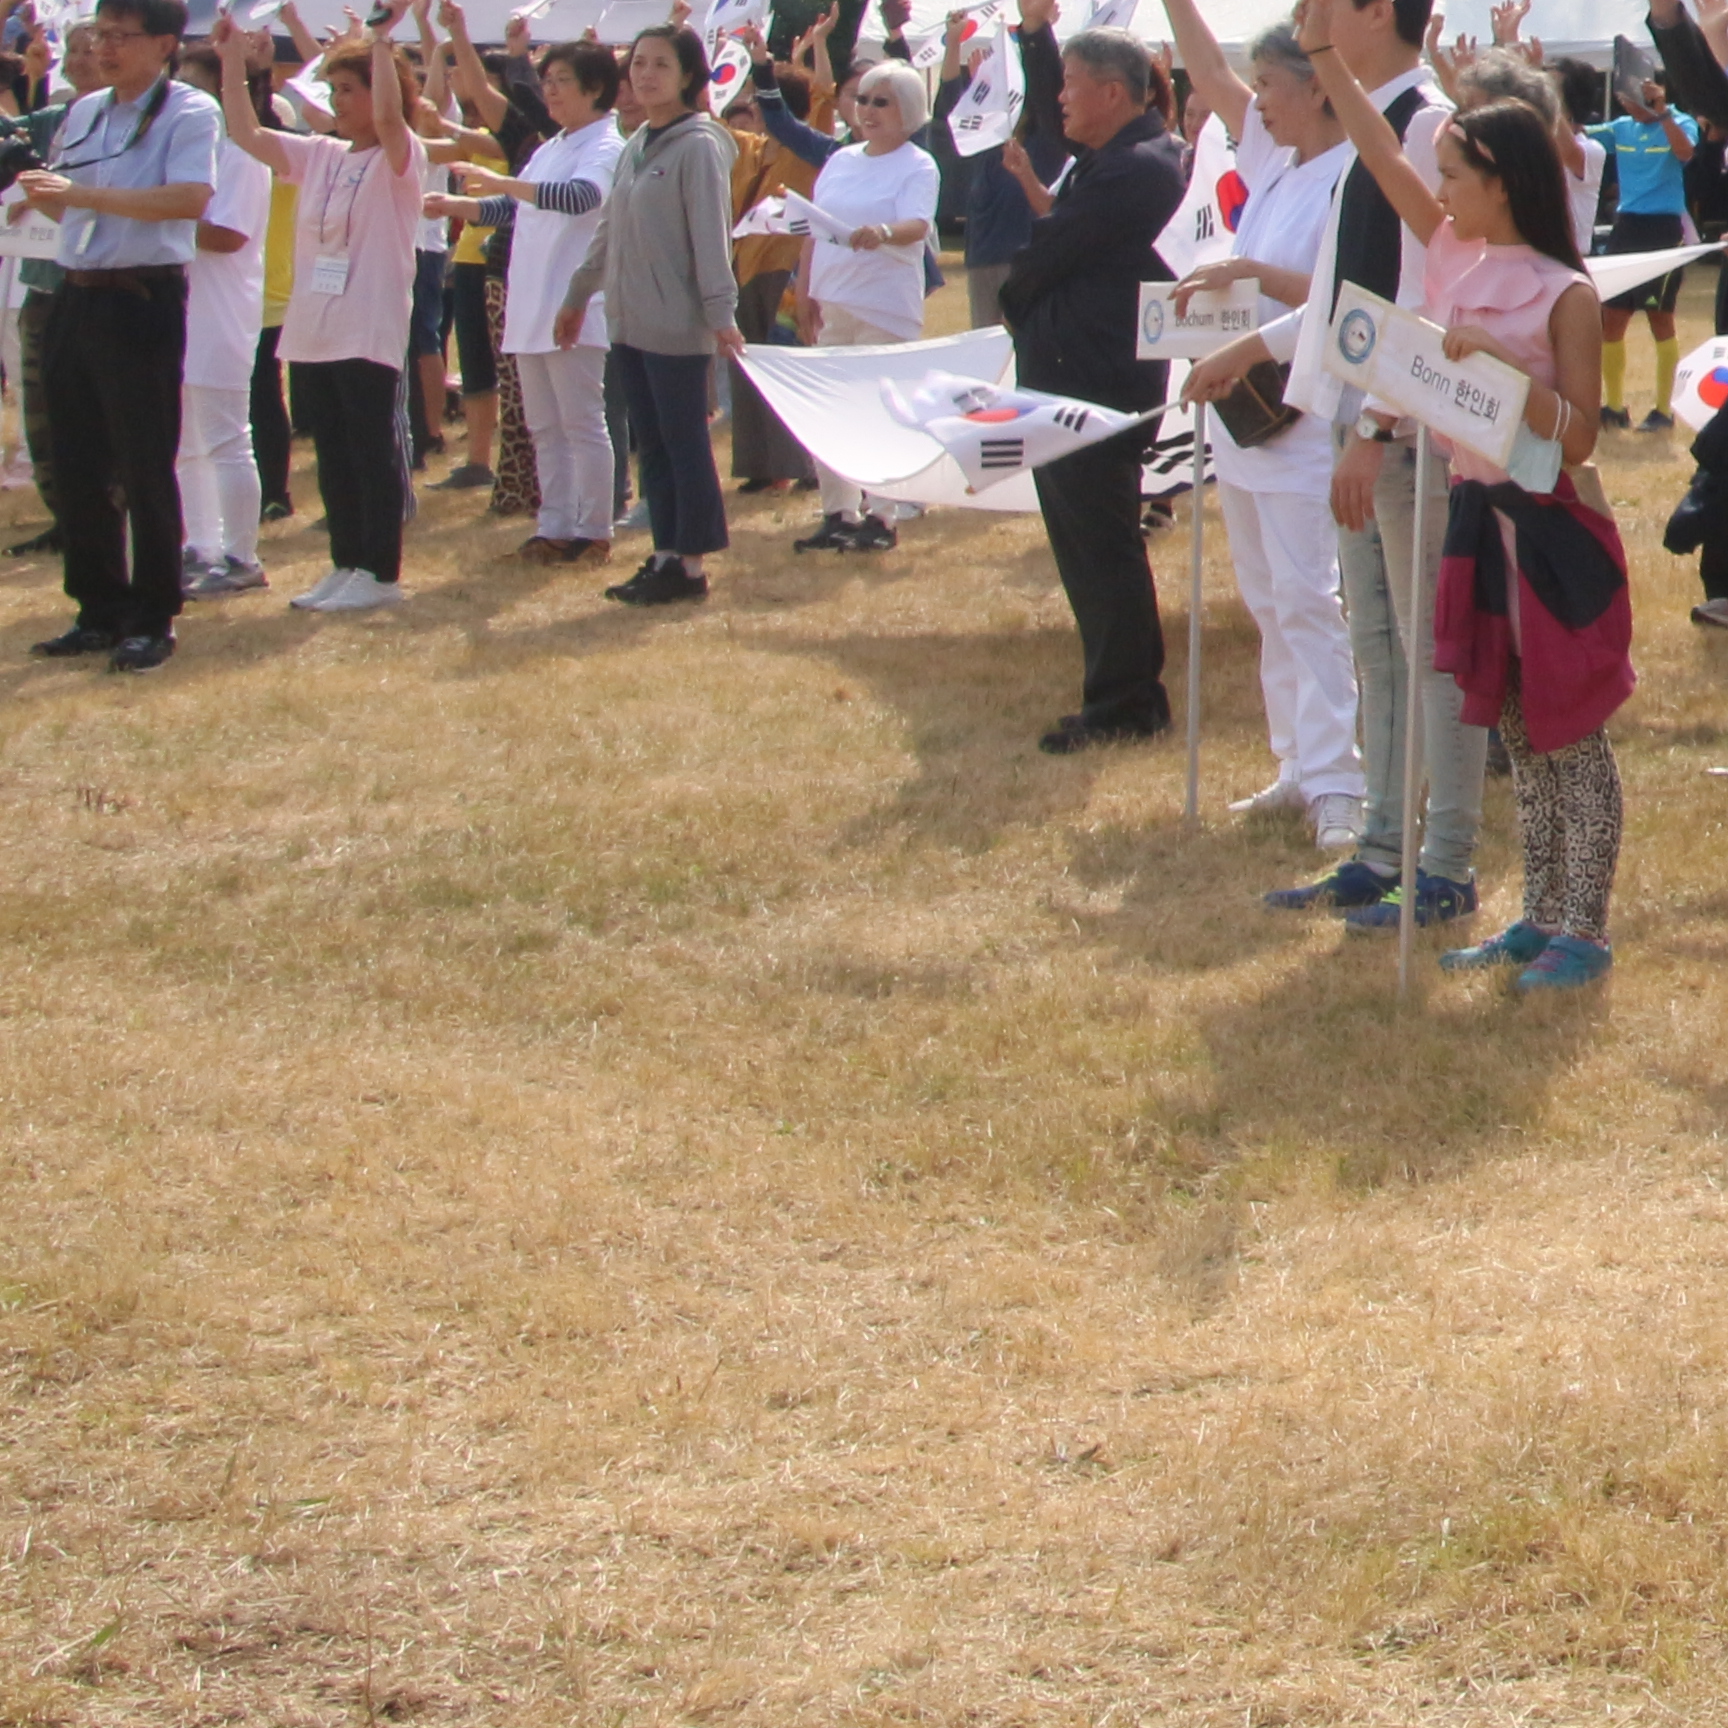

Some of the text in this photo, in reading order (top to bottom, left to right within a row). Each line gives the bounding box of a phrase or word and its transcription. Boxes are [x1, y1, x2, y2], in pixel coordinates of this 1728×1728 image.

[1221, 308, 1251, 331] 한인회
[1410, 354, 1501, 426] Bonn 한인회
